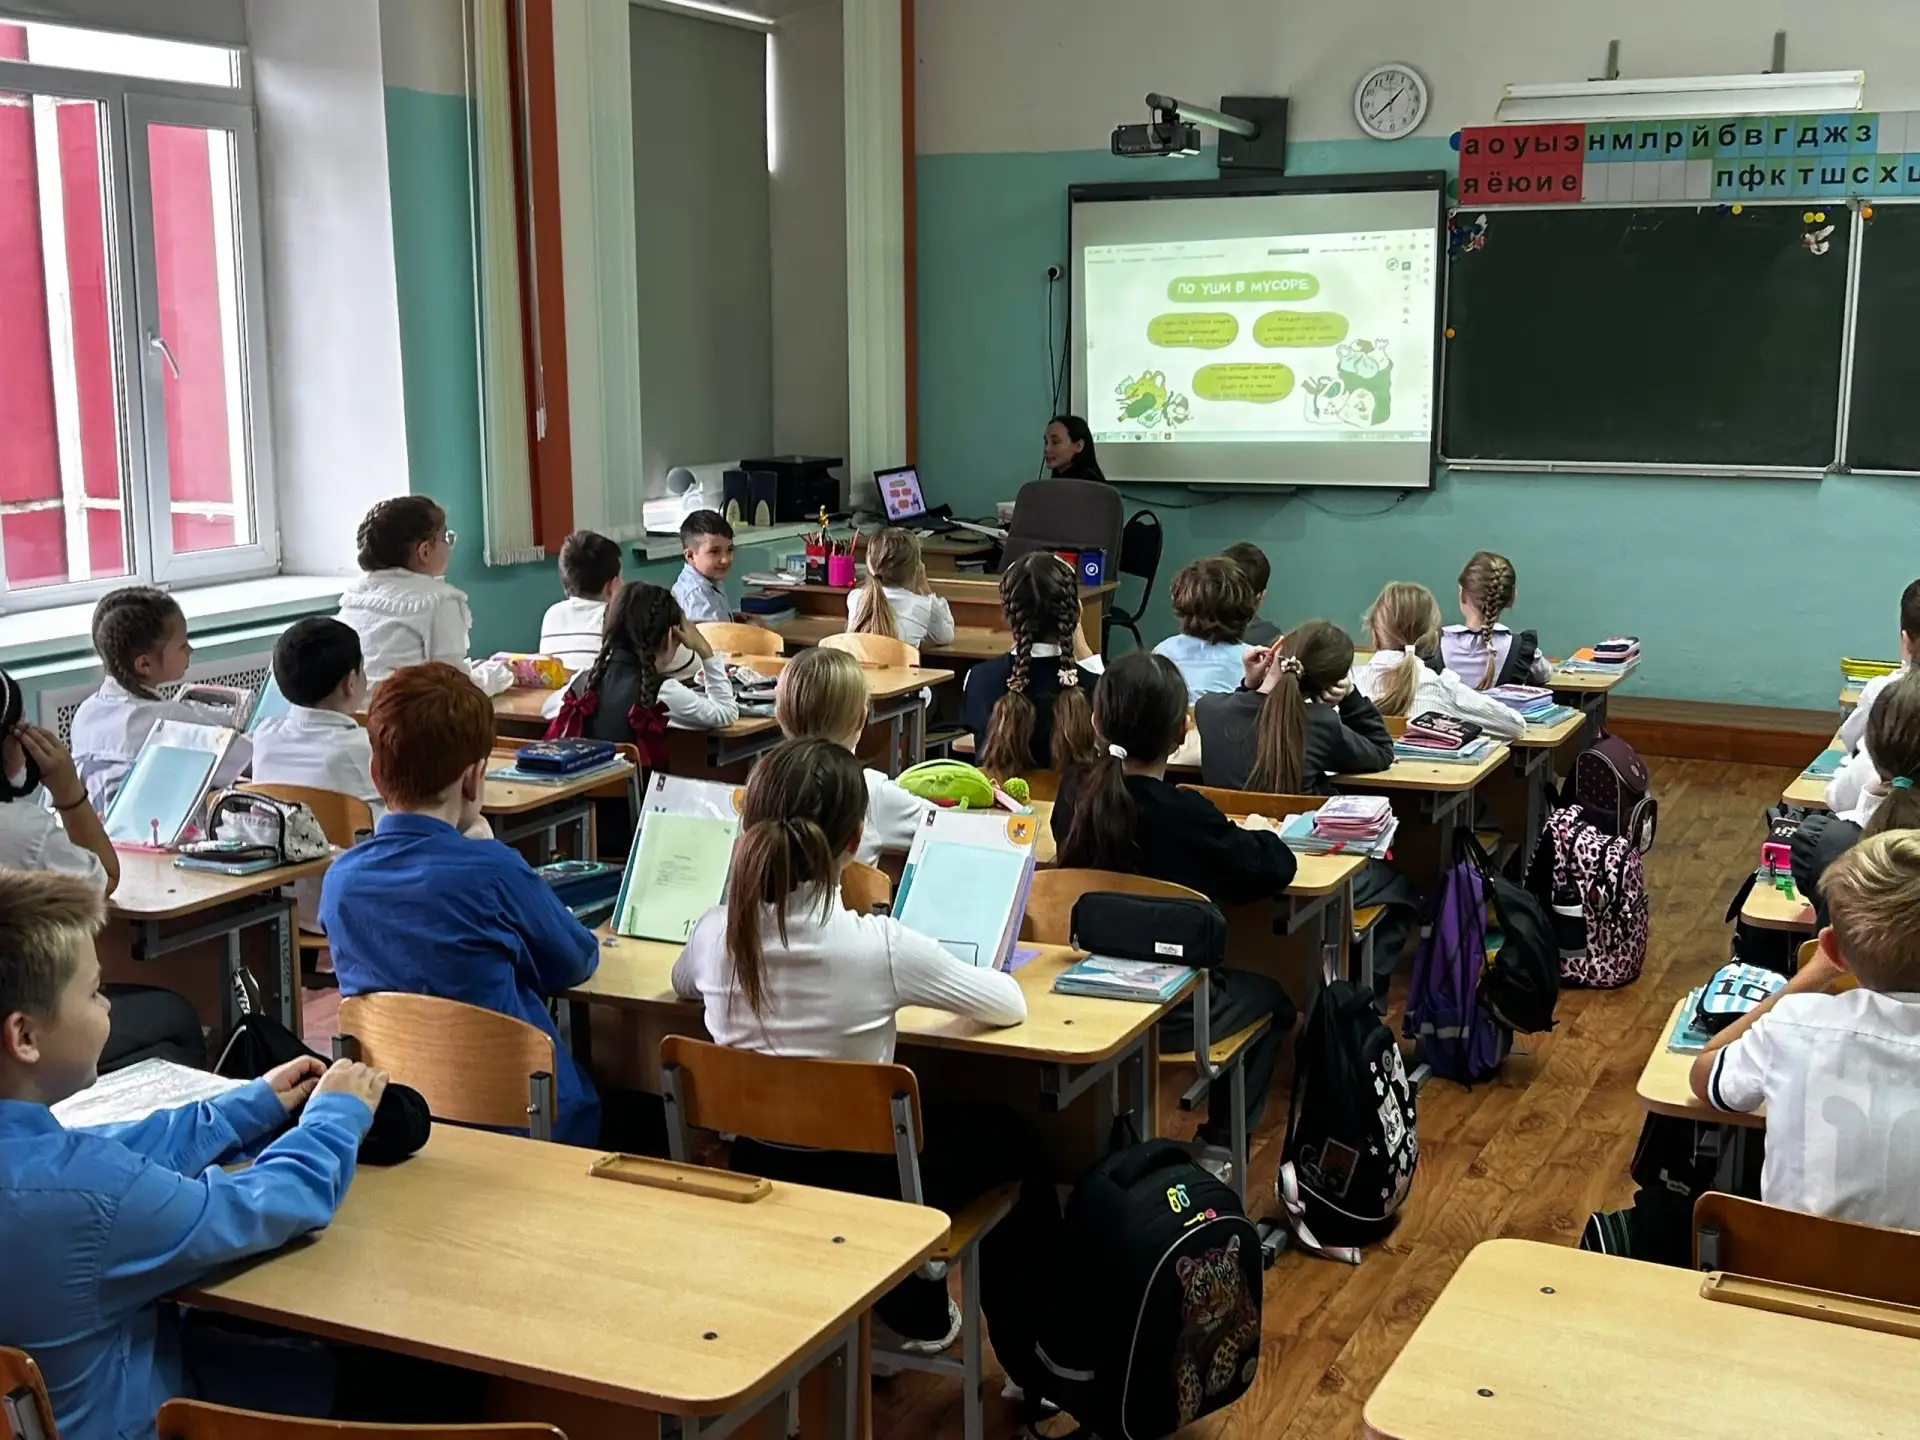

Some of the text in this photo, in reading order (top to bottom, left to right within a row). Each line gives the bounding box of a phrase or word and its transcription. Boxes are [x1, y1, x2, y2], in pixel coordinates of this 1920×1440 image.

[1177, 278, 1310, 295] ПО УШИ В МУСОРЕ
[1714, 979, 1773, 1003] 10
